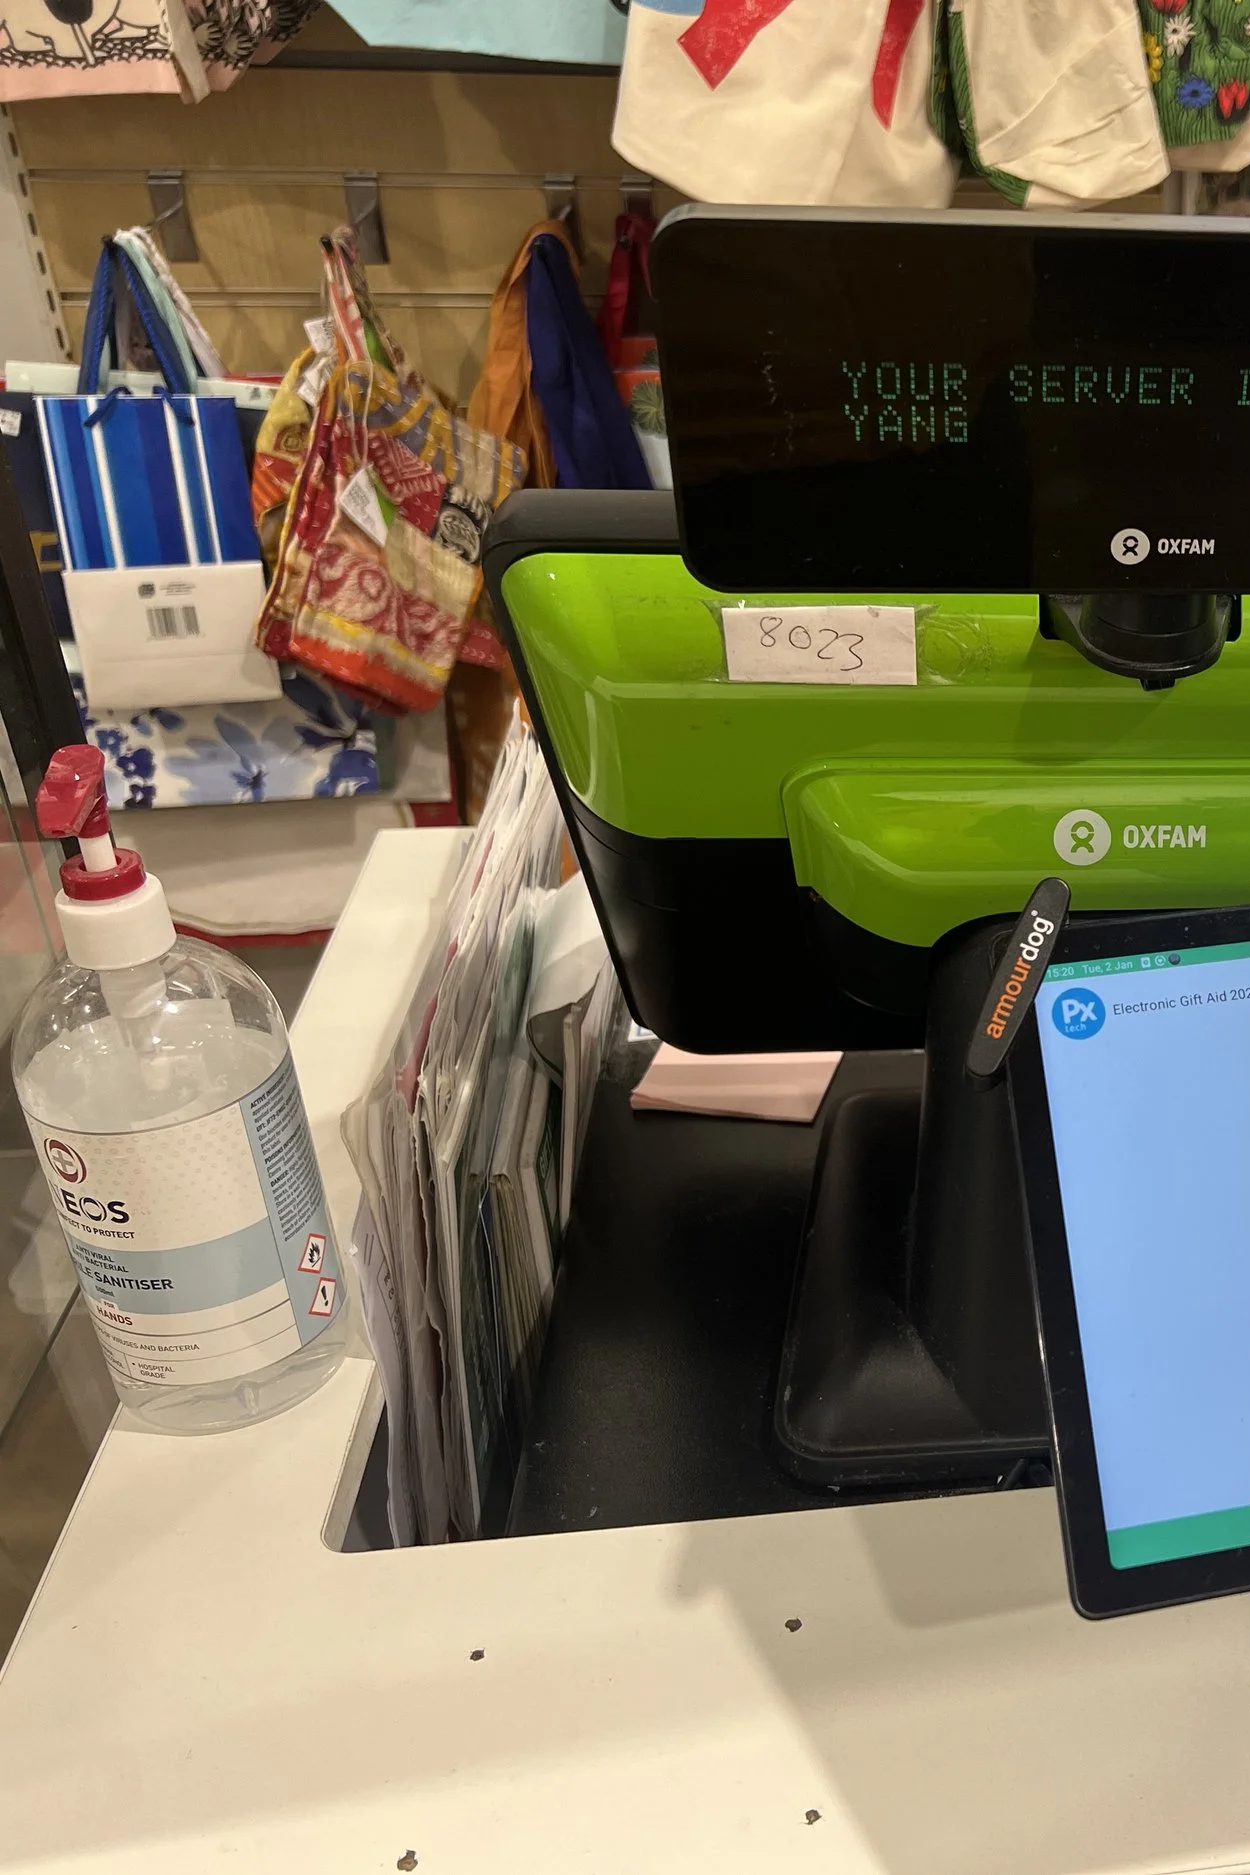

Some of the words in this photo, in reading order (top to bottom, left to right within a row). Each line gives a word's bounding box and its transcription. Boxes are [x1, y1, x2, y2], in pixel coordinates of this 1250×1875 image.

[842, 361, 968, 400] YOUR
[1009, 364, 1194, 405] SERVER
[844, 404, 968, 442] YANG
[1157, 537, 1215, 555] OXFAM
[759, 615, 865, 672] 8023
[1122, 825, 1207, 849] OXFAM
[1082, 963, 1104, 975] Tue,
[1105, 962, 1113, 972] 2
[1115, 960, 1133, 971] Jan
[1061, 998, 1098, 1024] Px
[1112, 997, 1177, 1016] Electronic
[1180, 992, 1203, 1007] Gift
[1206, 988, 1228, 1004] Aid
[1064, 1022, 1087, 1033] tech
[81, 1224, 92, 1233] TO
[93, 1227, 135, 1239] PROTECT
[86, 1256, 129, 1273] BACTERIAL
[90, 1251, 114, 1262] VIRAL
[94, 1271, 174, 1290] SANITISER
[96, 1305, 133, 1326] HANDS
[140, 1344, 156, 1352] AND
[157, 1343, 200, 1352] BACTERIA
[138, 1362, 176, 1373] HOSPITAL
[140, 1370, 166, 1379] GRADE
